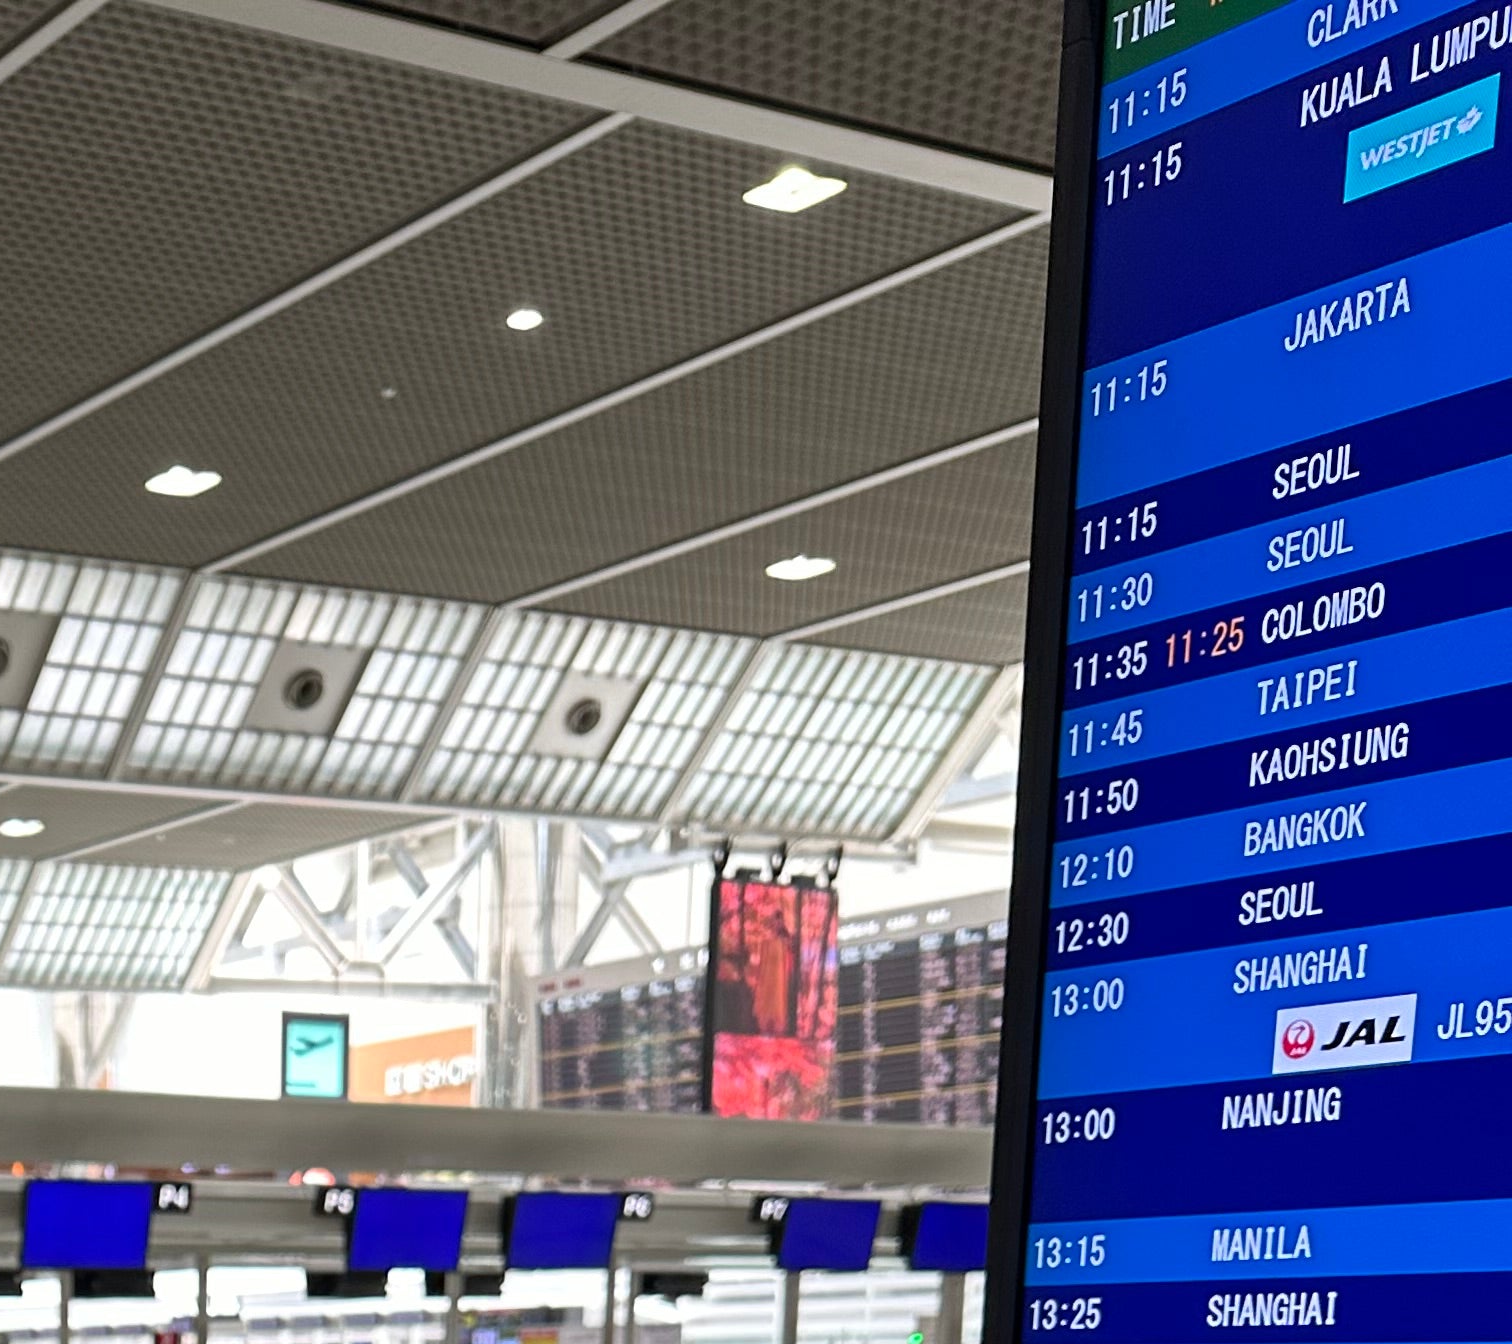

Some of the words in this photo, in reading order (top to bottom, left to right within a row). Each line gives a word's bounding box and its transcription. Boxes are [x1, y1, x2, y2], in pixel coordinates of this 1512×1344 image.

[1113, 0, 1176, 50] TIME
[1104, 141, 1182, 206] 11:15
[1300, 56, 1393, 128] KUALA
[1410, 5, 1512, 83] LUMPU
[1109, 68, 1187, 133] 11:15
[1360, 116, 1458, 171] WESTJET
[1092, 359, 1167, 416] 11:15
[1284, 277, 1411, 352] JAKARTA
[1082, 501, 1158, 555] 11:15
[1272, 443, 1360, 500] SEOUL
[1078, 572, 1153, 622] 11:30
[1267, 518, 1354, 572] SEOUL
[1073, 640, 1148, 690] 11:35
[1166, 616, 1245, 667] 11:25
[1261, 582, 1386, 644] COLOMBO
[1069, 709, 1142, 756] 11:45
[1257, 660, 1357, 715] TAIPEI
[1064, 778, 1139, 823] 11:50
[1249, 722, 1410, 787] KAOHSIUNG
[1061, 845, 1133, 888] 12:10
[1244, 801, 1367, 857] BANGKOK
[1056, 912, 1129, 953] 12:30
[1238, 881, 1323, 926] SEOUL
[1053, 978, 1124, 1017] 13:00
[1233, 943, 1368, 994] SHANGHAI
[1320, 1015, 1406, 1051] JAL
[1043, 1107, 1115, 1145] 13:00
[1221, 1086, 1342, 1130] NANJING
[1035, 1235, 1105, 1268] 13:15
[1212, 1225, 1311, 1261] MANILA
[1030, 1297, 1101, 1330] 13:25
[1206, 1291, 1338, 1327] SHANGHAI
